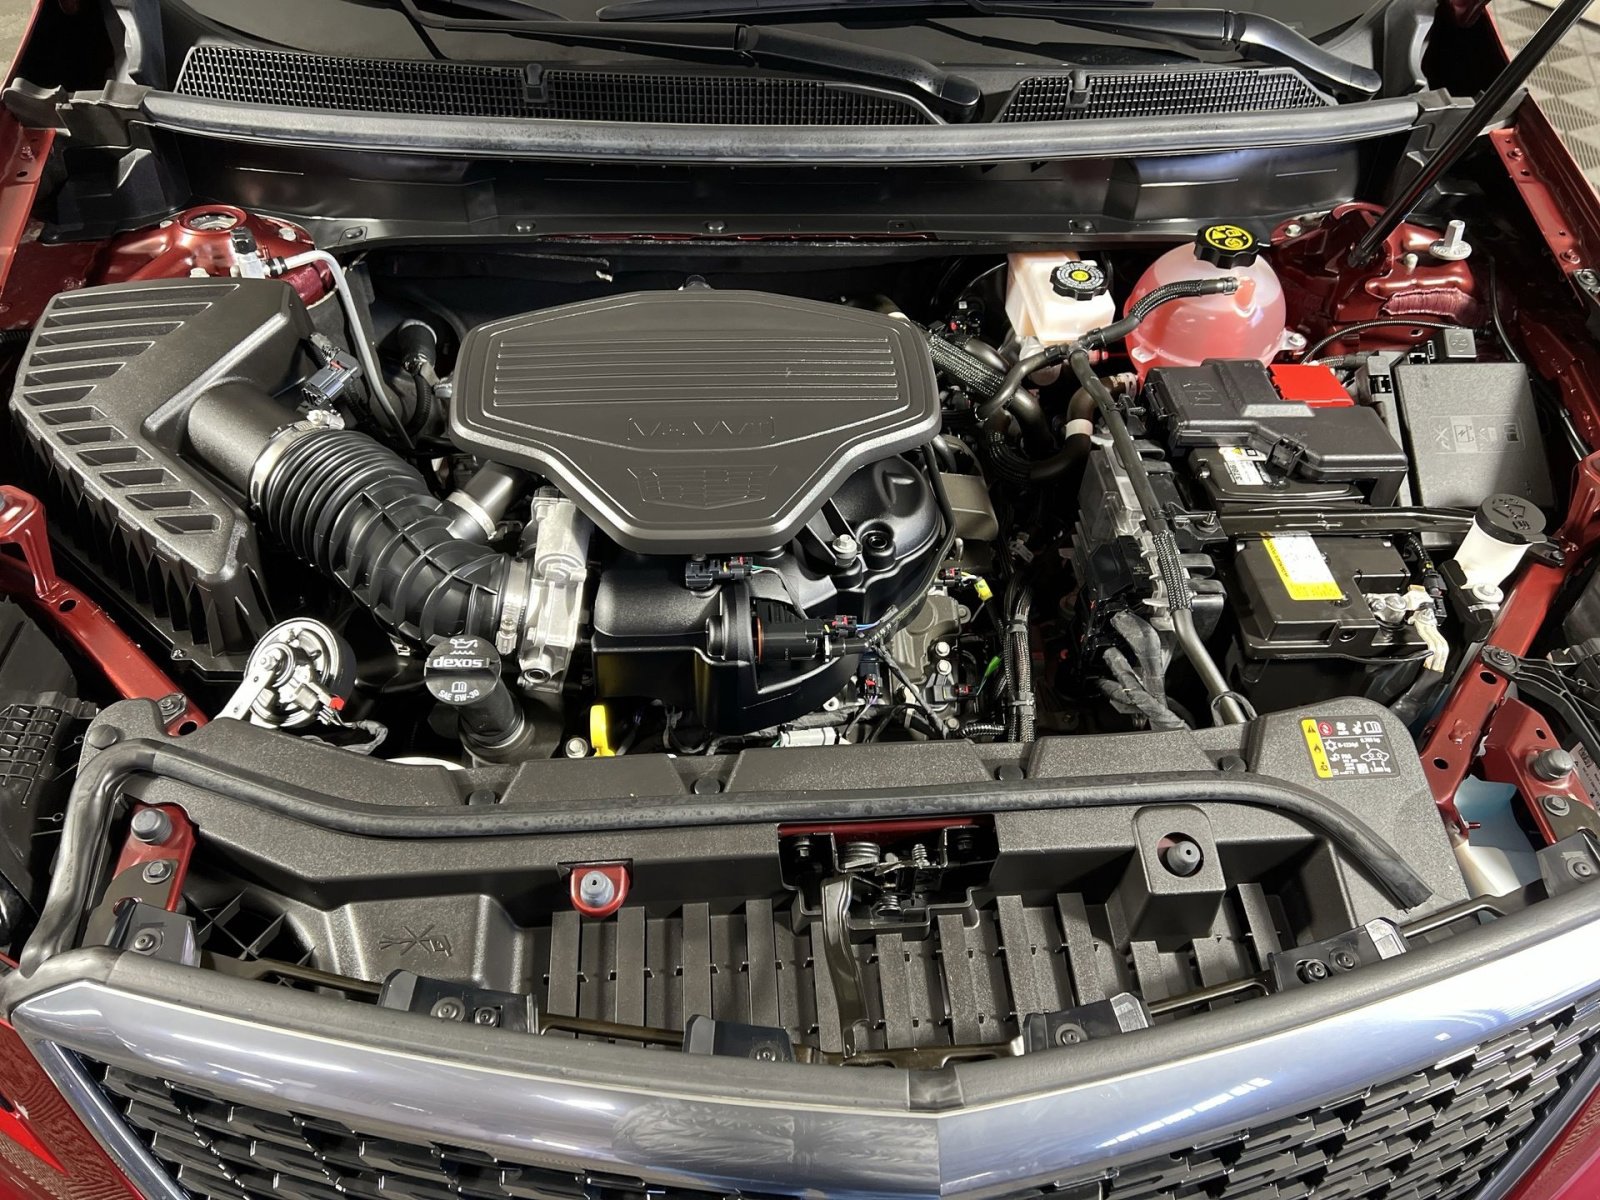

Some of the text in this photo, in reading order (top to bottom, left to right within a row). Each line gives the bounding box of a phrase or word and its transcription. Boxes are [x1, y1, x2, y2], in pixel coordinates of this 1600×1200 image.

[433, 656, 484, 668] dexos
[438, 689, 480, 702] SAE 5W-30
